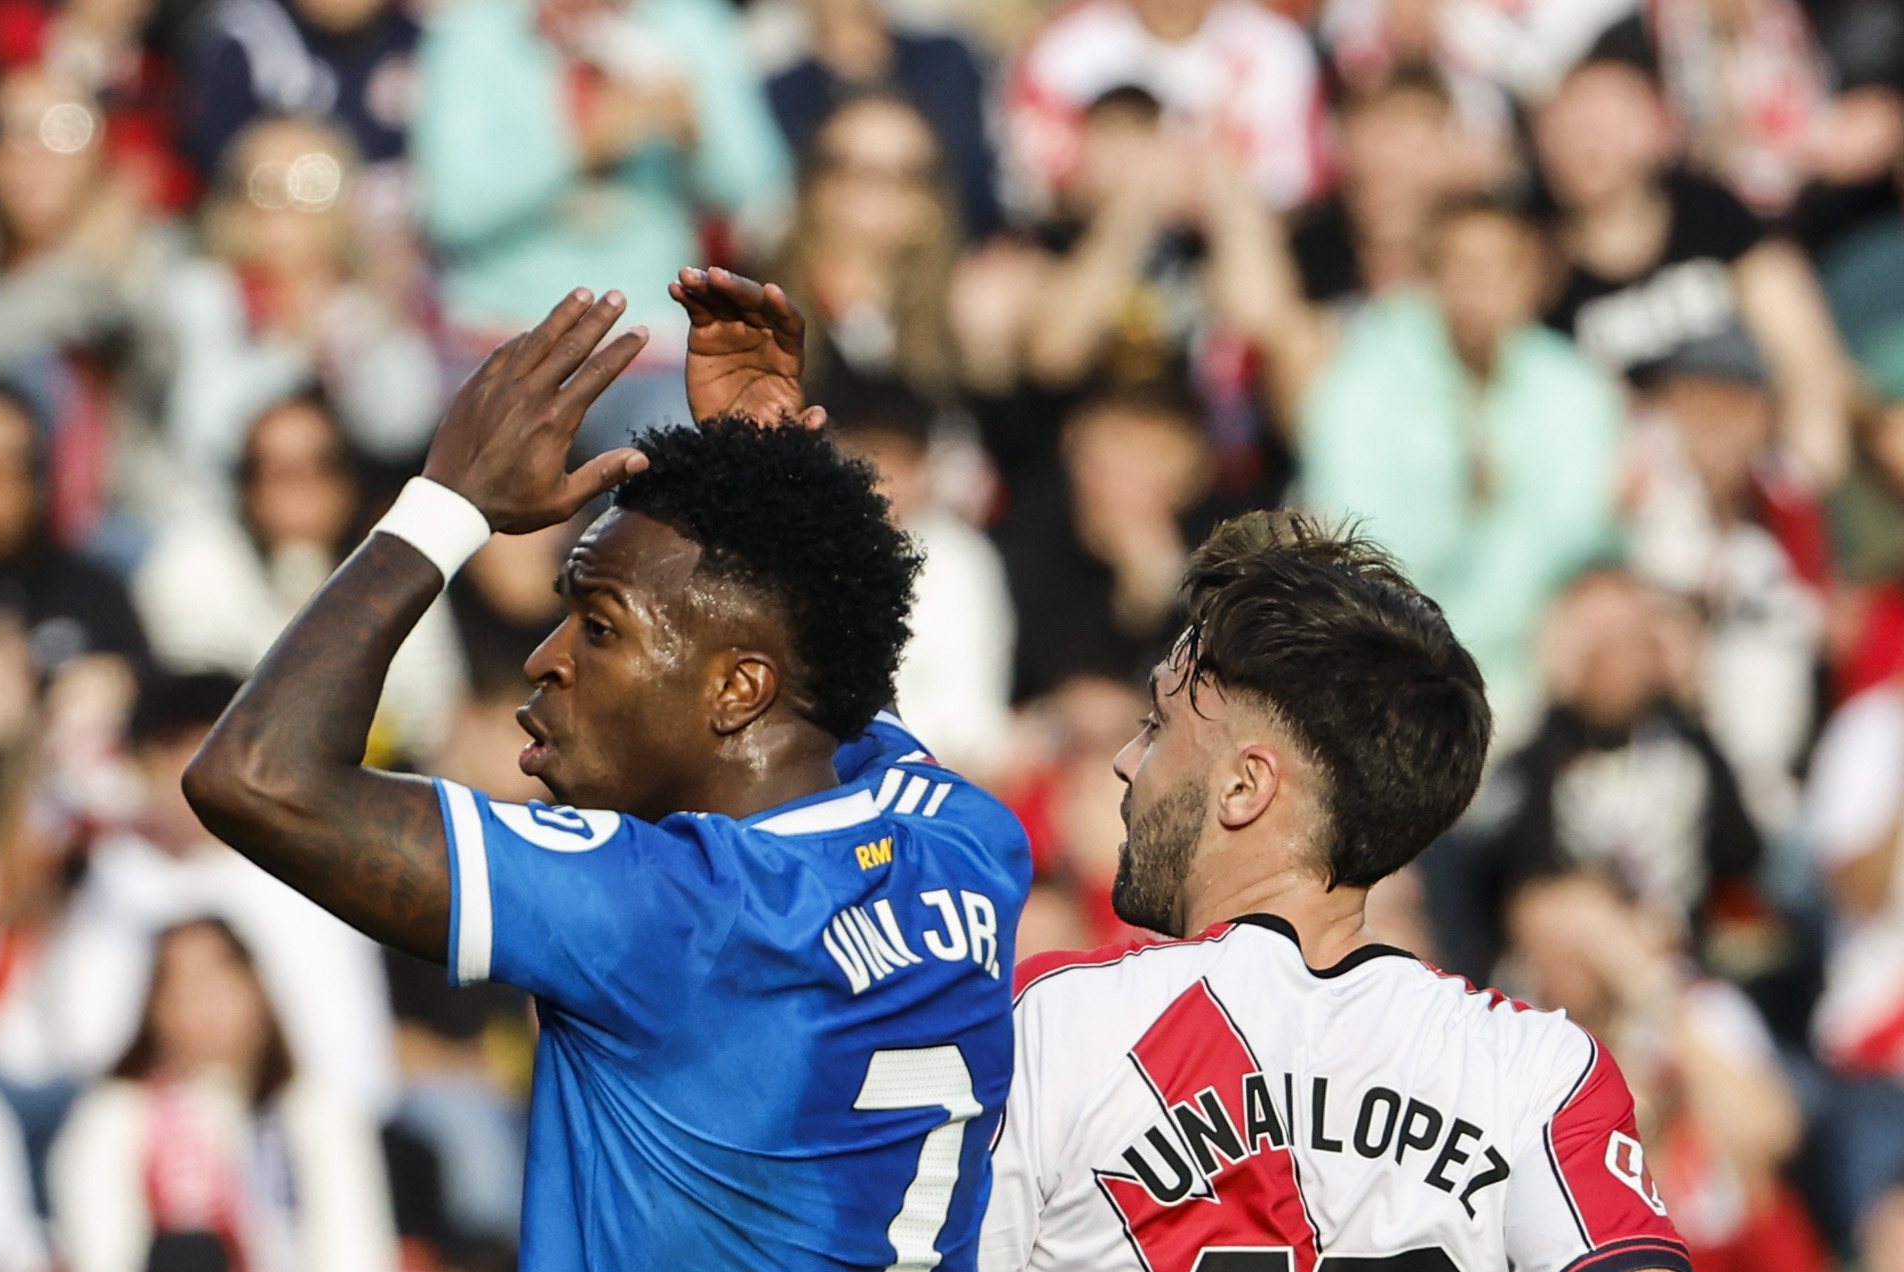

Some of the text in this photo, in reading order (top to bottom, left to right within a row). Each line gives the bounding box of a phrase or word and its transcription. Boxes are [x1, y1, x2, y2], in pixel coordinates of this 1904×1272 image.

[854, 834, 894, 872] RM
[822, 897, 924, 996] VINI
[1120, 1071, 1512, 1222] UNAI LOPEZ
